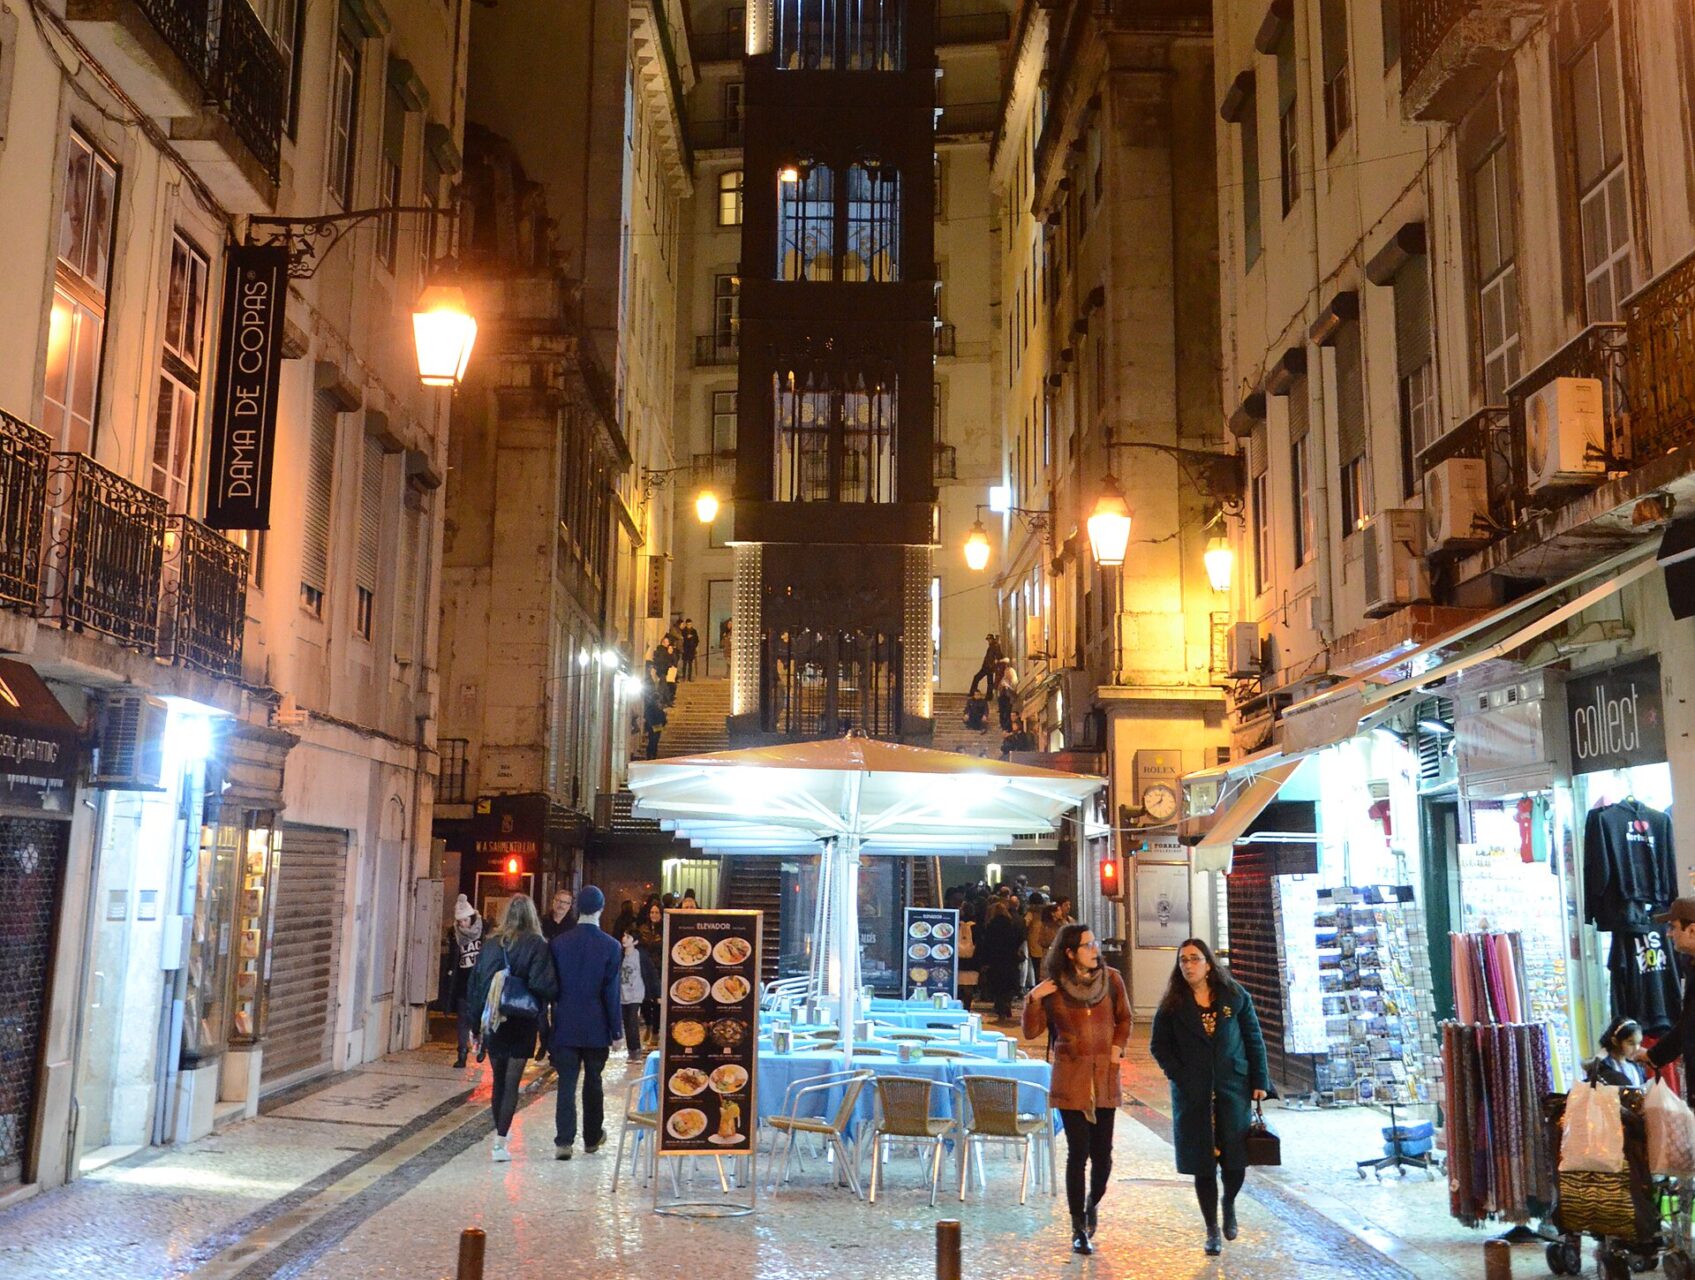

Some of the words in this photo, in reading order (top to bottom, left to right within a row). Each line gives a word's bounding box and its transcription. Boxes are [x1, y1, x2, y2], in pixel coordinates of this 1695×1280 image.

[238, 281, 268, 374] COPAS
[235, 385, 260, 417] DE
[228, 430, 256, 498] DAMA
[1575, 683, 1640, 759] collect
[1143, 766, 1176, 774] ROLEX
[1627, 821, 1634, 832] I
[696, 922, 731, 930] ELEVADOR
[1634, 931, 1661, 953] LIS
